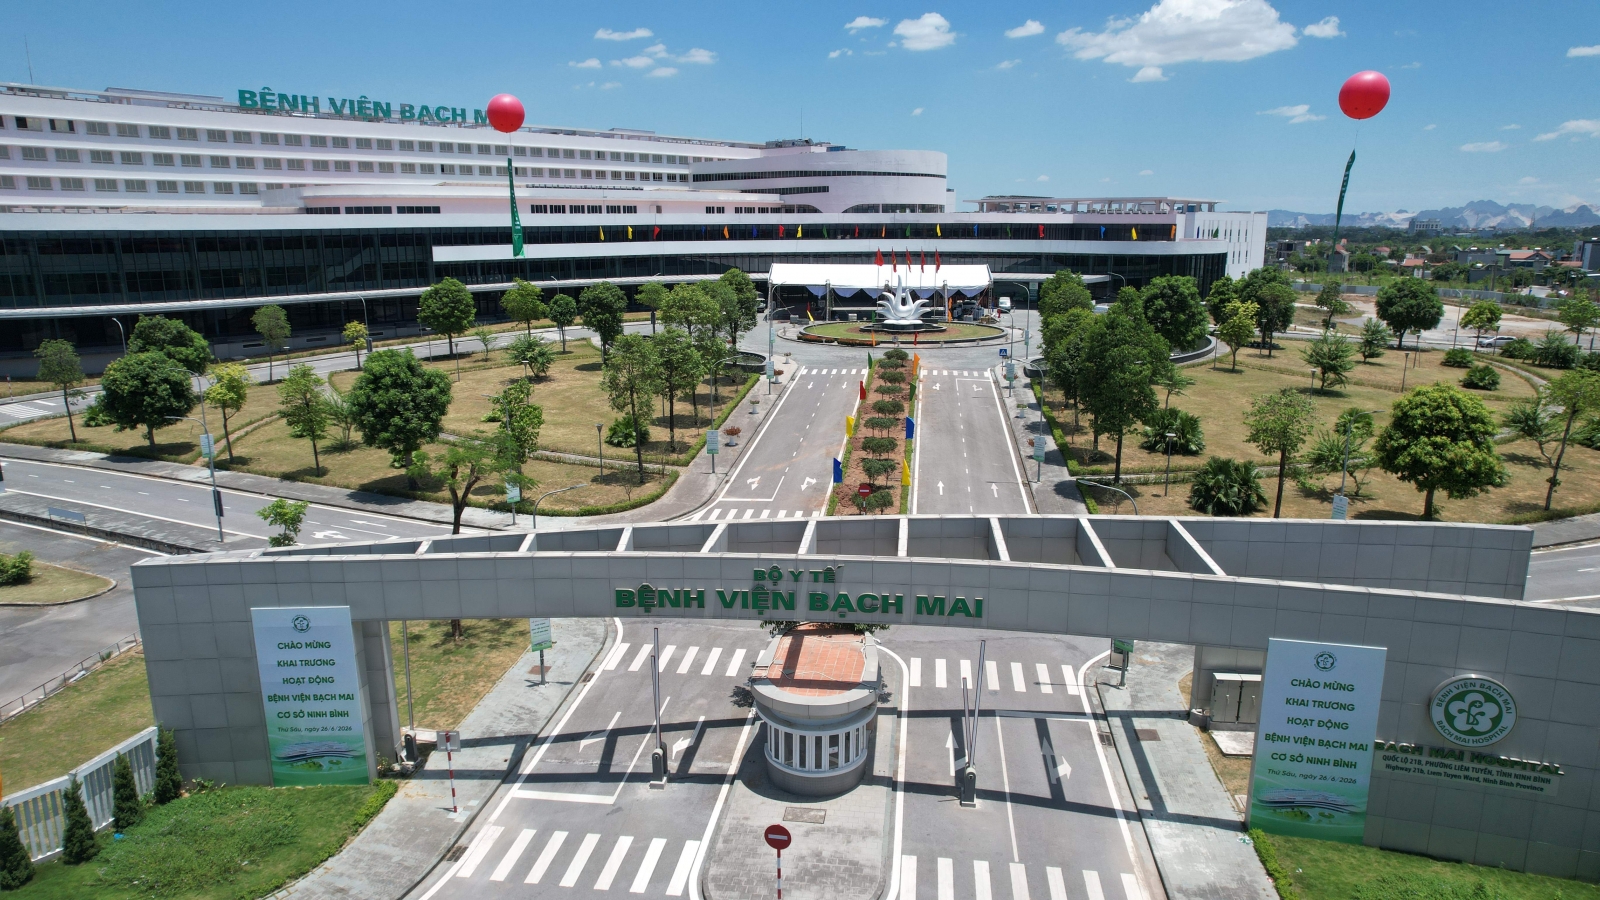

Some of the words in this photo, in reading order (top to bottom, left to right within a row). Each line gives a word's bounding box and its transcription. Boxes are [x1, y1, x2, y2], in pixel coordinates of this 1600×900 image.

[754, 564, 783, 586] BỘ
[788, 569, 804, 582] Y
[809, 564, 844, 583] TẾ
[615, 582, 705, 614] BỆNH
[715, 585, 796, 615] VIỆN
[808, 590, 904, 618] BẠCH
[916, 594, 983, 618] MAI
[278, 641, 302, 649] CHÀO
[305, 640, 331, 649] MỪNG
[282, 677, 306, 686] HOẠT
[308, 675, 334, 686] ĐỘNG
[1290, 678, 1320, 689] CHÀO
[1323, 681, 1355, 692] MỪNG
[268, 694, 290, 703] BỆNH
[292, 693, 310, 703] VIỆN
[313, 694, 336, 702] BẠCH
[1285, 697, 1309, 707] KHAI
[1312, 700, 1355, 712] TRƯƠNG
[1436, 688, 1453, 707] BỆNH
[1454, 681, 1476, 690] VIỆN
[1479, 683, 1504, 698] BẠCH
[1502, 698, 1512, 714] MAI
[293, 709, 305, 718] SỞ
[329, 709, 349, 718] BÌNH
[1287, 717, 1315, 728] HOẠT
[1317, 719, 1349, 730] ĐỘNG
[1436, 720, 1454, 738] BACH
[1454, 735, 1470, 744] MAI
[1472, 725, 1508, 744] HOSPITAL
[1265, 733, 1290, 744] BỆNH
[1293, 736, 1316, 747] VIỆN
[1318, 740, 1346, 749] BẠCH
[1349, 742, 1368, 752] MAI
[1271, 752, 1287, 760] CƠ
[1289, 754, 1304, 762] SỞ
[1306, 756, 1330, 766] NINH
[1333, 759, 1357, 769] BÌNH
[1374, 740, 1423, 755] BACH
[1429, 747, 1464, 761] MAI
[1470, 752, 1564, 775] HOSPITAL
[1319, 774, 1357, 784] 26/6/2026
[1385, 763, 1412, 773] Highway
[1444, 771, 1461, 780] Tuyen
[1516, 782, 1544, 792] Province
[1514, 773, 1532, 781] NINH
